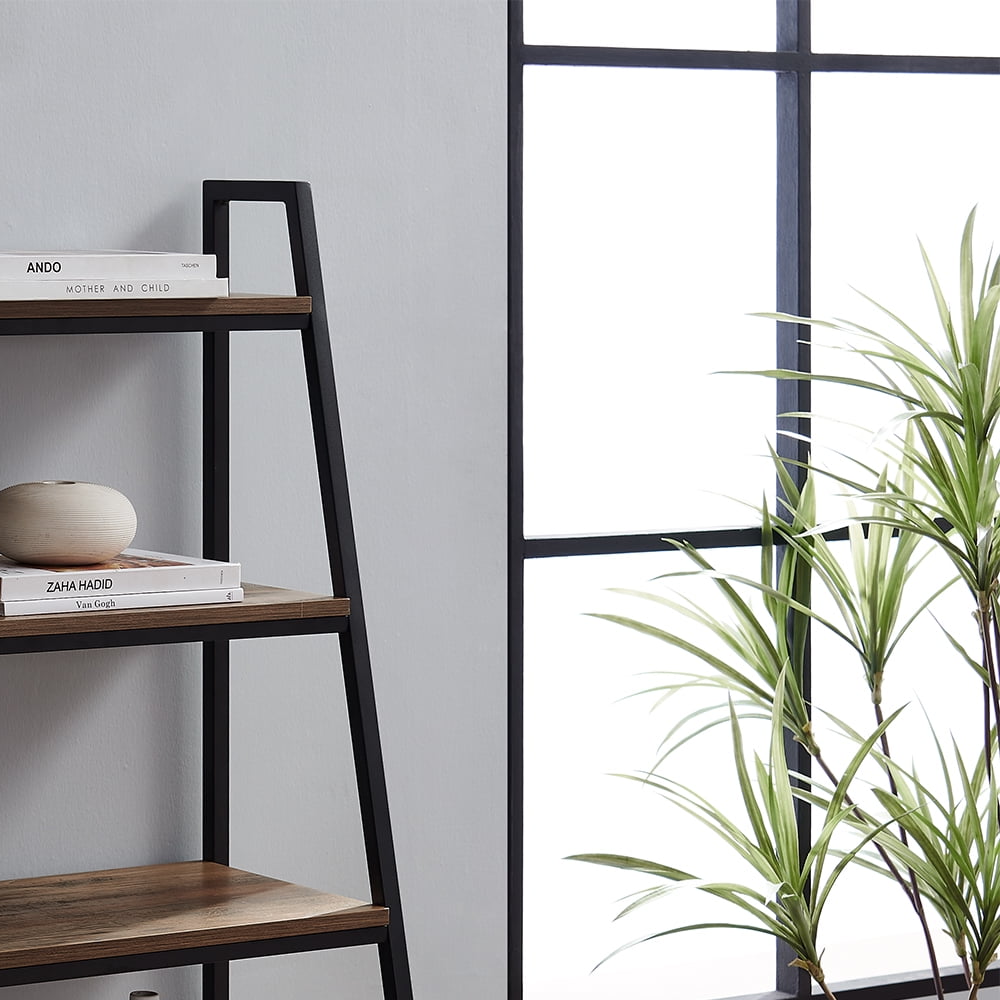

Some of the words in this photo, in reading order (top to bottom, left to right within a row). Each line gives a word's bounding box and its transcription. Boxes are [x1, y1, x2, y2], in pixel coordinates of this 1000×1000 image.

[26, 261, 62, 273] ANDO
[65, 284, 105, 293] MOTHER
[112, 284, 134, 292] AND
[141, 283, 170, 292] CHILD
[46, 581, 77, 593] ZAHA
[78, 579, 113, 591] HADID
[76, 600, 93, 609] Van
[94, 599, 116, 609] Gogh
